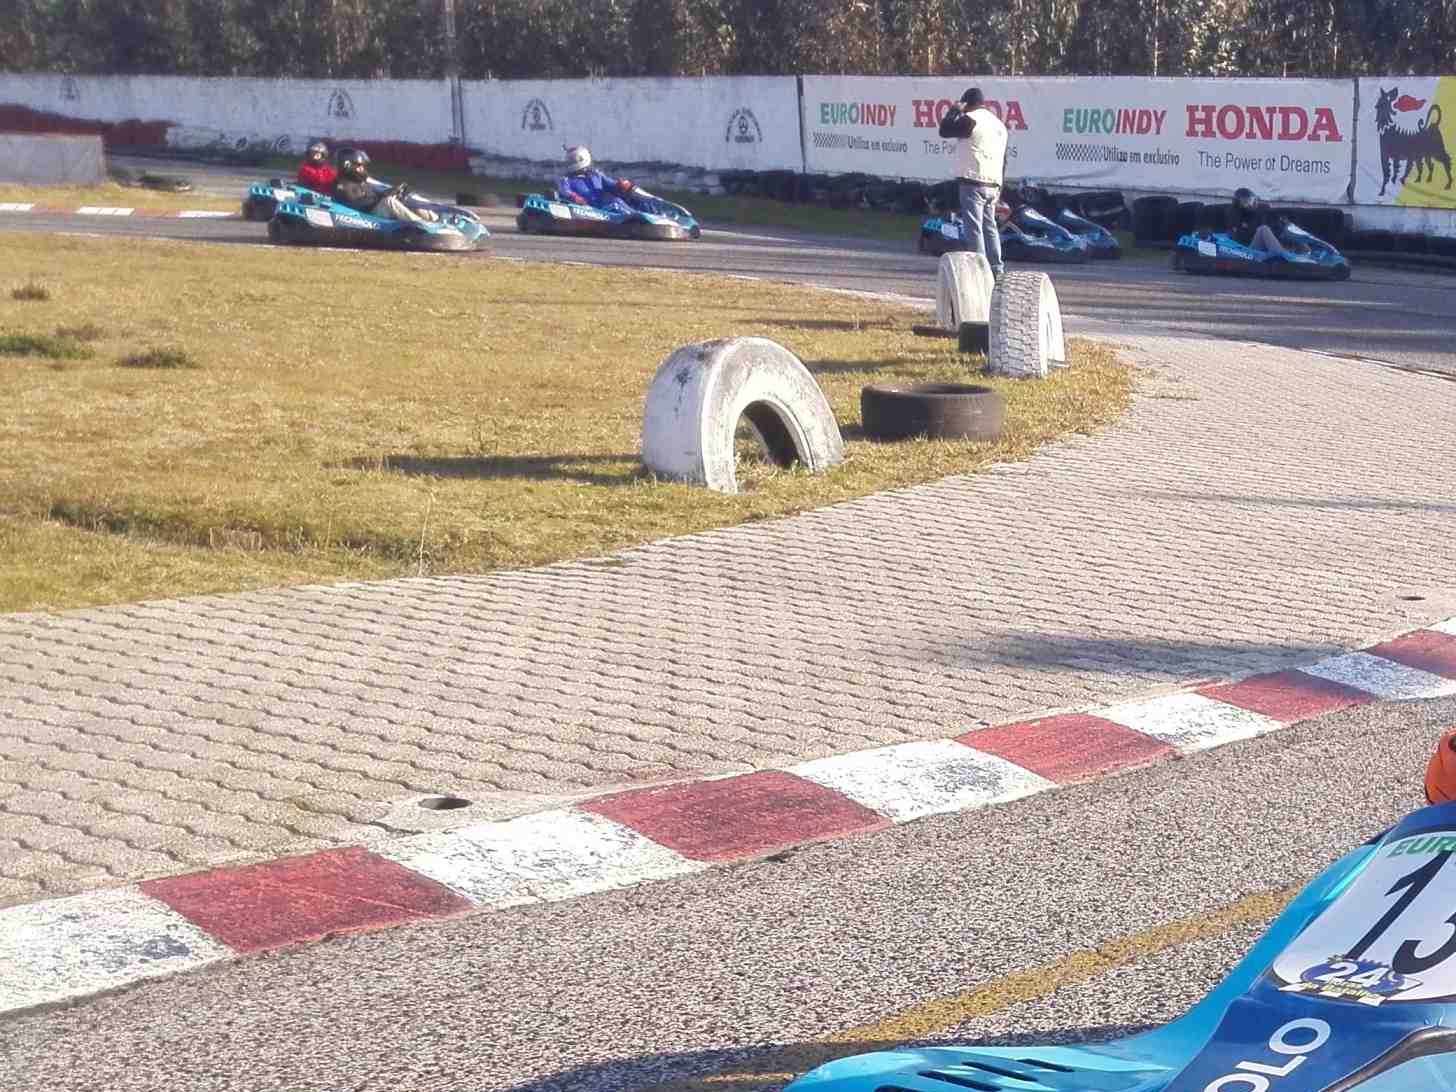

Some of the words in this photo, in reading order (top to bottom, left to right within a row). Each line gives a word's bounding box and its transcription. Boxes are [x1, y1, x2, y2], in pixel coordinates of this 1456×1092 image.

[820, 103, 897, 127] EUROINDY
[1063, 108, 1167, 135] EUROINDY
[1185, 104, 1343, 142] HONDA
[923, 140, 940, 154] The
[1198, 151, 1221, 169] The
[1225, 152, 1262, 170] Power
[1265, 157, 1275, 170] of
[1280, 155, 1331, 174] Dreams
